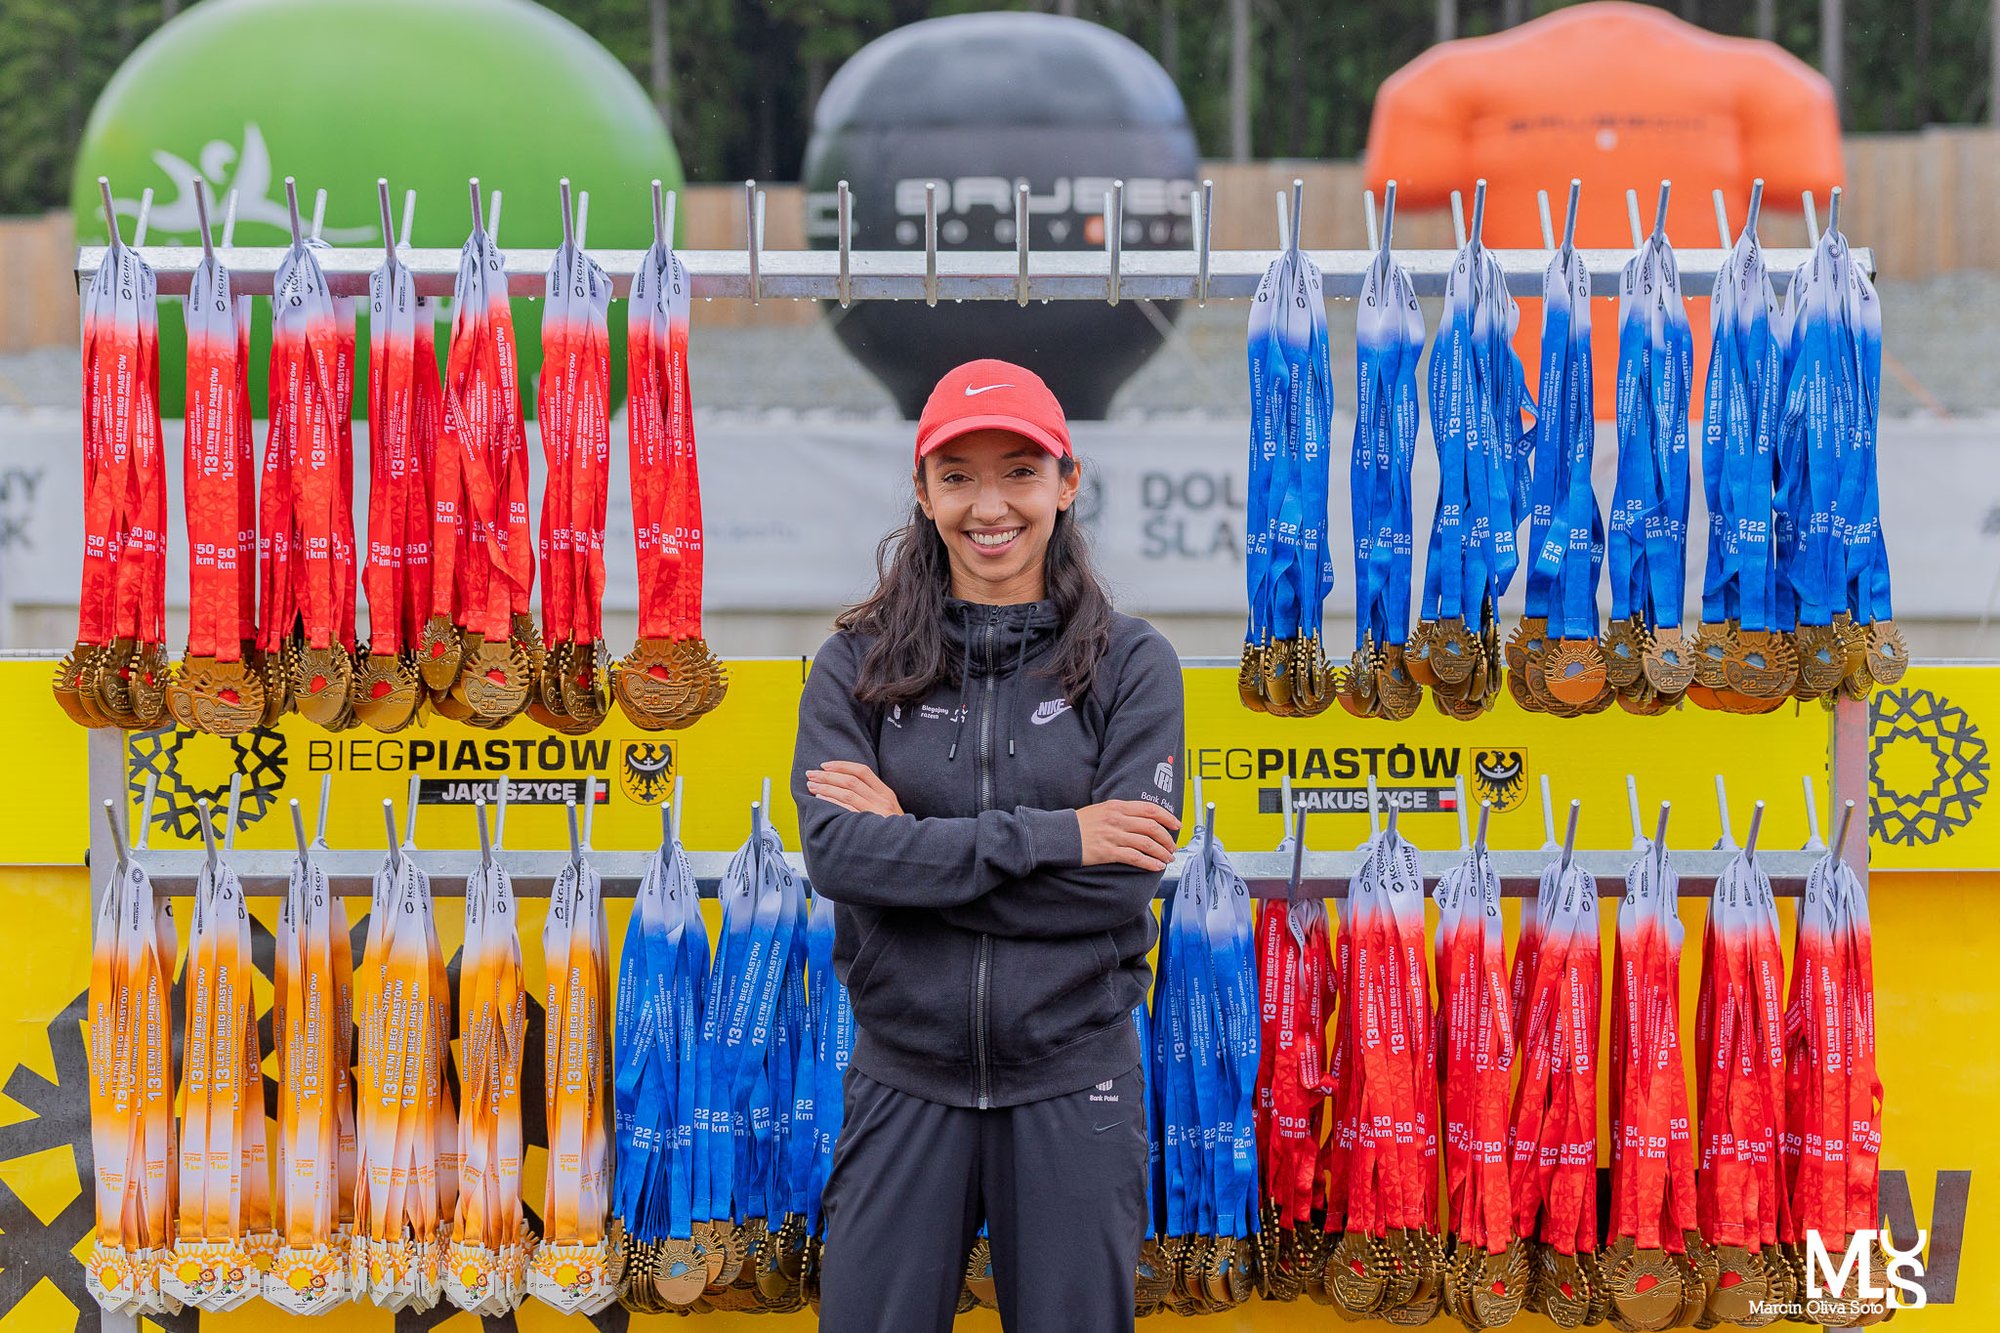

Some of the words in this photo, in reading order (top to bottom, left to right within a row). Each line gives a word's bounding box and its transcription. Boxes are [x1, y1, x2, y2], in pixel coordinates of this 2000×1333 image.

[496, 327, 508, 366] PIASTÓW
[1452, 330, 1460, 368] PIASTÓW
[117, 354, 127, 394] PIASTÓW
[501, 368, 509, 387] BIEG
[1360, 362, 1368, 402] PIASTÓW
[208, 367, 219, 407] PIASTÓW
[1711, 380, 1719, 399] BIEG
[117, 396, 125, 416] BIEG
[504, 389, 512, 413] LETNI
[208, 408, 216, 428] BIEG
[1710, 401, 1718, 424] LETNI
[1449, 418, 1461, 438] 13
[1708, 425, 1721, 445] 13
[115, 443, 126, 464] 13
[206, 431, 215, 455] LETNI
[1306, 442, 1318, 461] 13
[204, 456, 218, 476] 13
[1362, 450, 1371, 470] 13
[437, 501, 455, 512] 50
[510, 502, 525, 514] 50
[1443, 505, 1460, 515] 22
[1534, 505, 1551, 515] 22
[1441, 518, 1459, 526] km
[88, 535, 105, 547] 50
[1495, 532, 1513, 543] 22
[1570, 529, 1588, 539] 22
[87, 549, 103, 557] km
[218, 548, 235, 559] 50
[1495, 545, 1514, 553] km
[217, 561, 236, 570] km
[1038, 698, 1066, 716] NIKE
[441, 782, 577, 801] JAKUSZYCE
[1141, 791, 1160, 804] Bank
[1268, 917, 1277, 955] PIASTÓW
[743, 942, 761, 980] PIASTÓW
[767, 940, 781, 980] PIASTÓW
[196, 967, 205, 1013] PIASTÓW
[217, 966, 227, 1011] PIASTÓW
[569, 967, 580, 1013] PIASTÓW
[1571, 967, 1579, 1006] PIASTÓW
[1762, 960, 1771, 999] PIASTÓW
[1822, 966, 1832, 1005] PIASTÓW
[148, 976, 157, 1019] PIASTÓW
[308, 973, 317, 1019] PIASTÓW
[739, 982, 749, 1000] BIEG
[763, 982, 773, 1000] BIEG
[1265, 979, 1273, 1002] LETNI
[390, 979, 403, 1025] PIASTÓW
[1264, 1003, 1277, 1022] 13
[733, 1002, 745, 1026] LETNI
[757, 1002, 769, 1026] LETNI
[1390, 1009, 1398, 1033] LETNI
[194, 1017, 202, 1037] BIEG
[217, 1014, 226, 1037] BIEG
[570, 1016, 578, 1038] BIEG
[388, 1028, 398, 1050] BIEG
[727, 1027, 741, 1047] 13
[751, 1027, 766, 1047] 13
[1392, 1034, 1405, 1055] 13
[192, 1040, 200, 1068] LETNI
[216, 1040, 225, 1067] LETNI
[306, 1047, 314, 1074] LETNI
[569, 1042, 577, 1069] LETNI
[1771, 1047, 1782, 1068] 13
[1827, 1053, 1841, 1073] 13
[385, 1053, 395, 1081] LETNI
[1576, 1054, 1589, 1075] 13
[147, 1077, 162, 1101] 13
[191, 1070, 204, 1093] 13
[215, 1068, 230, 1093] 13
[303, 1076, 317, 1099] 13
[566, 1071, 581, 1095] 13
[382, 1083, 398, 1107] 13
[797, 1100, 813, 1110] 22
[713, 1112, 728, 1122] 22
[1395, 1122, 1412, 1132] 50
[1670, 1119, 1687, 1129] 50
[632, 1137, 649, 1149] km
[634, 1127, 652, 1139] 22
[1671, 1132, 1688, 1140] km
[1825, 1140, 1843, 1150] 50
[1825, 1153, 1843, 1161] km
